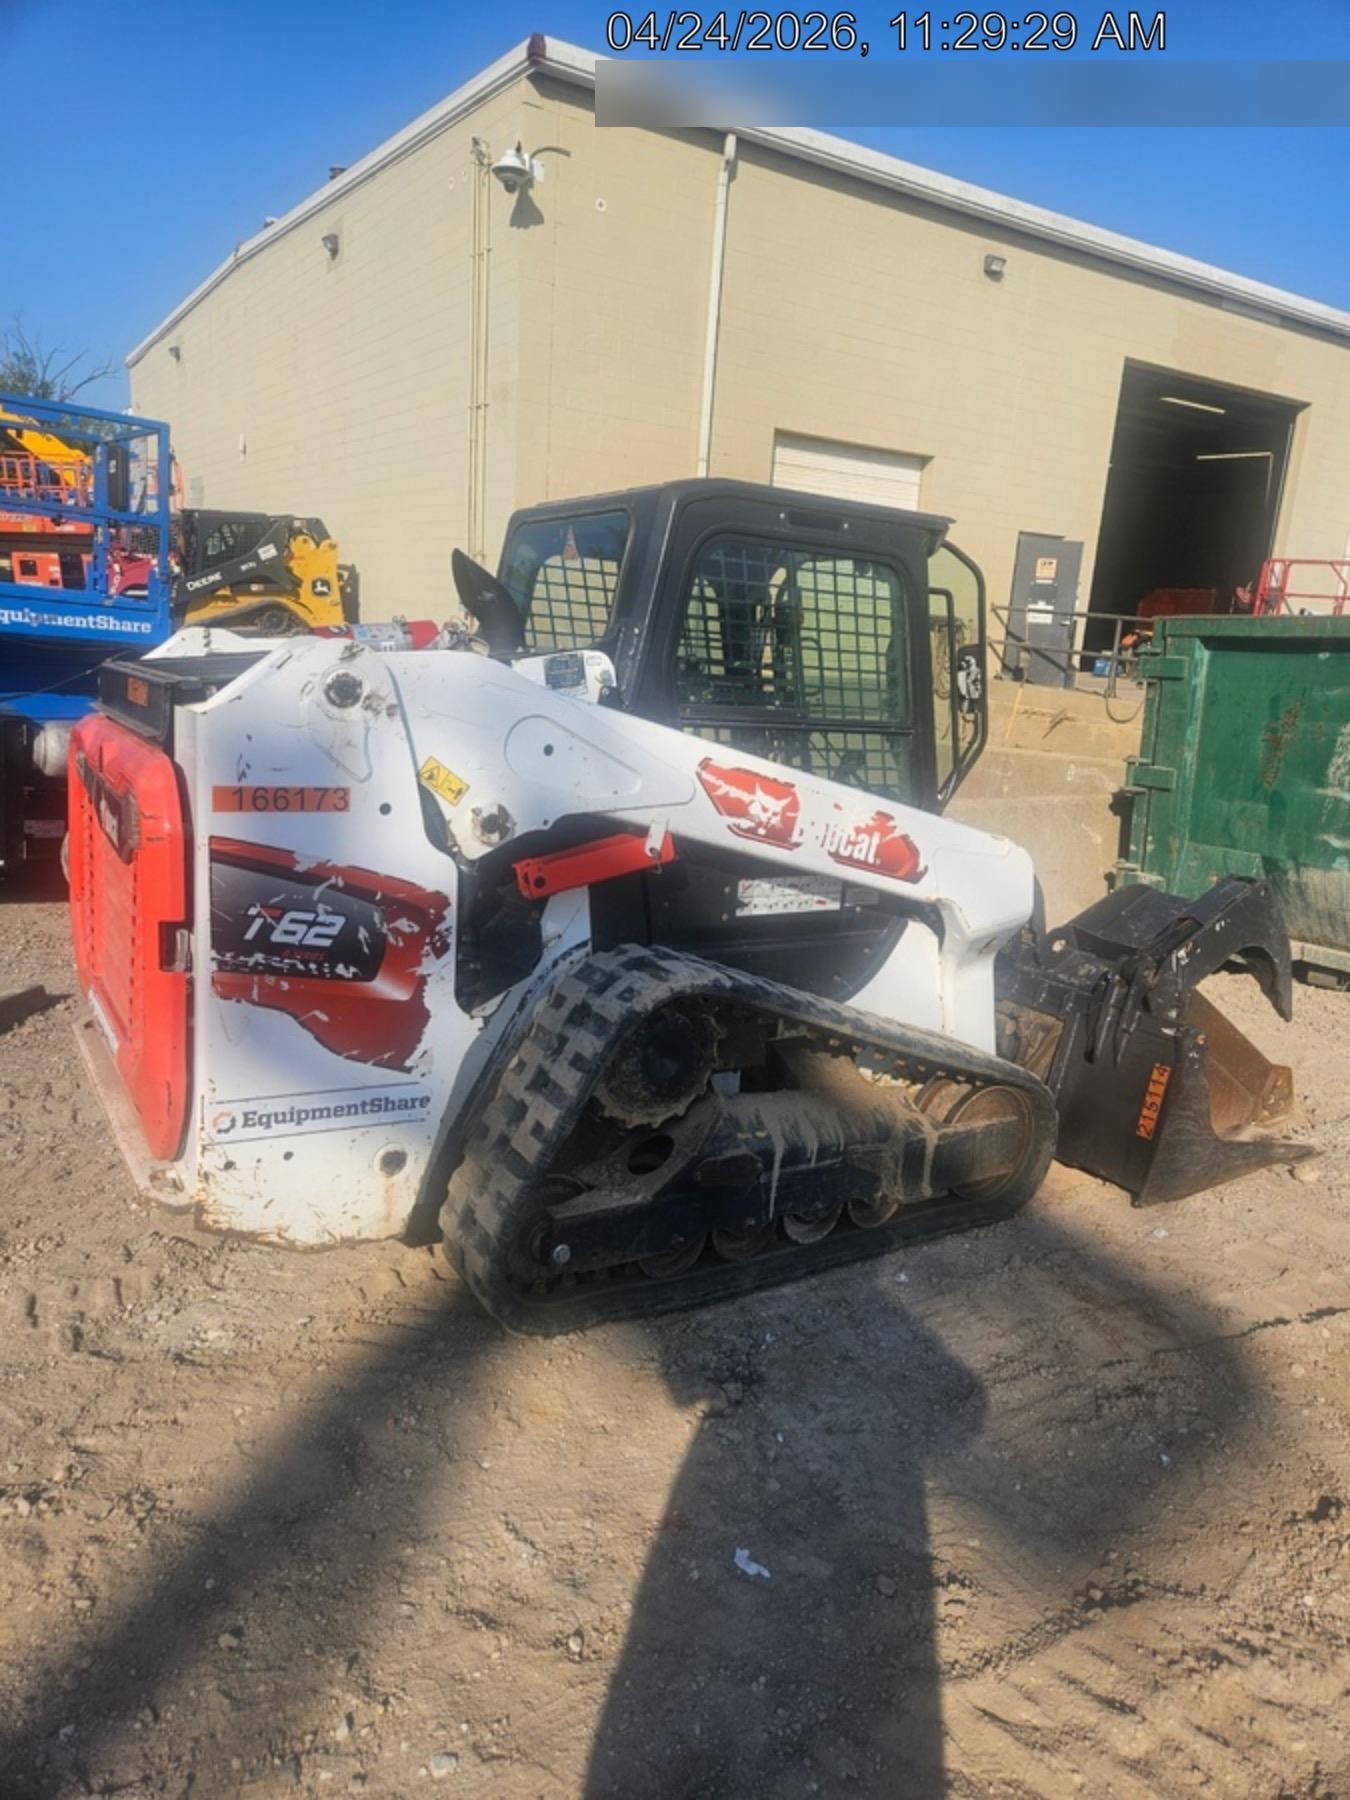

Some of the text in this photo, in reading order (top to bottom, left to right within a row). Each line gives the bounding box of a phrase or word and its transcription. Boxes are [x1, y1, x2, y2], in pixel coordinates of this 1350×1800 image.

[232, 786, 349, 812] 166173
[243, 906, 347, 947] T62
[241, 1095, 431, 1130] EquipmentShare
